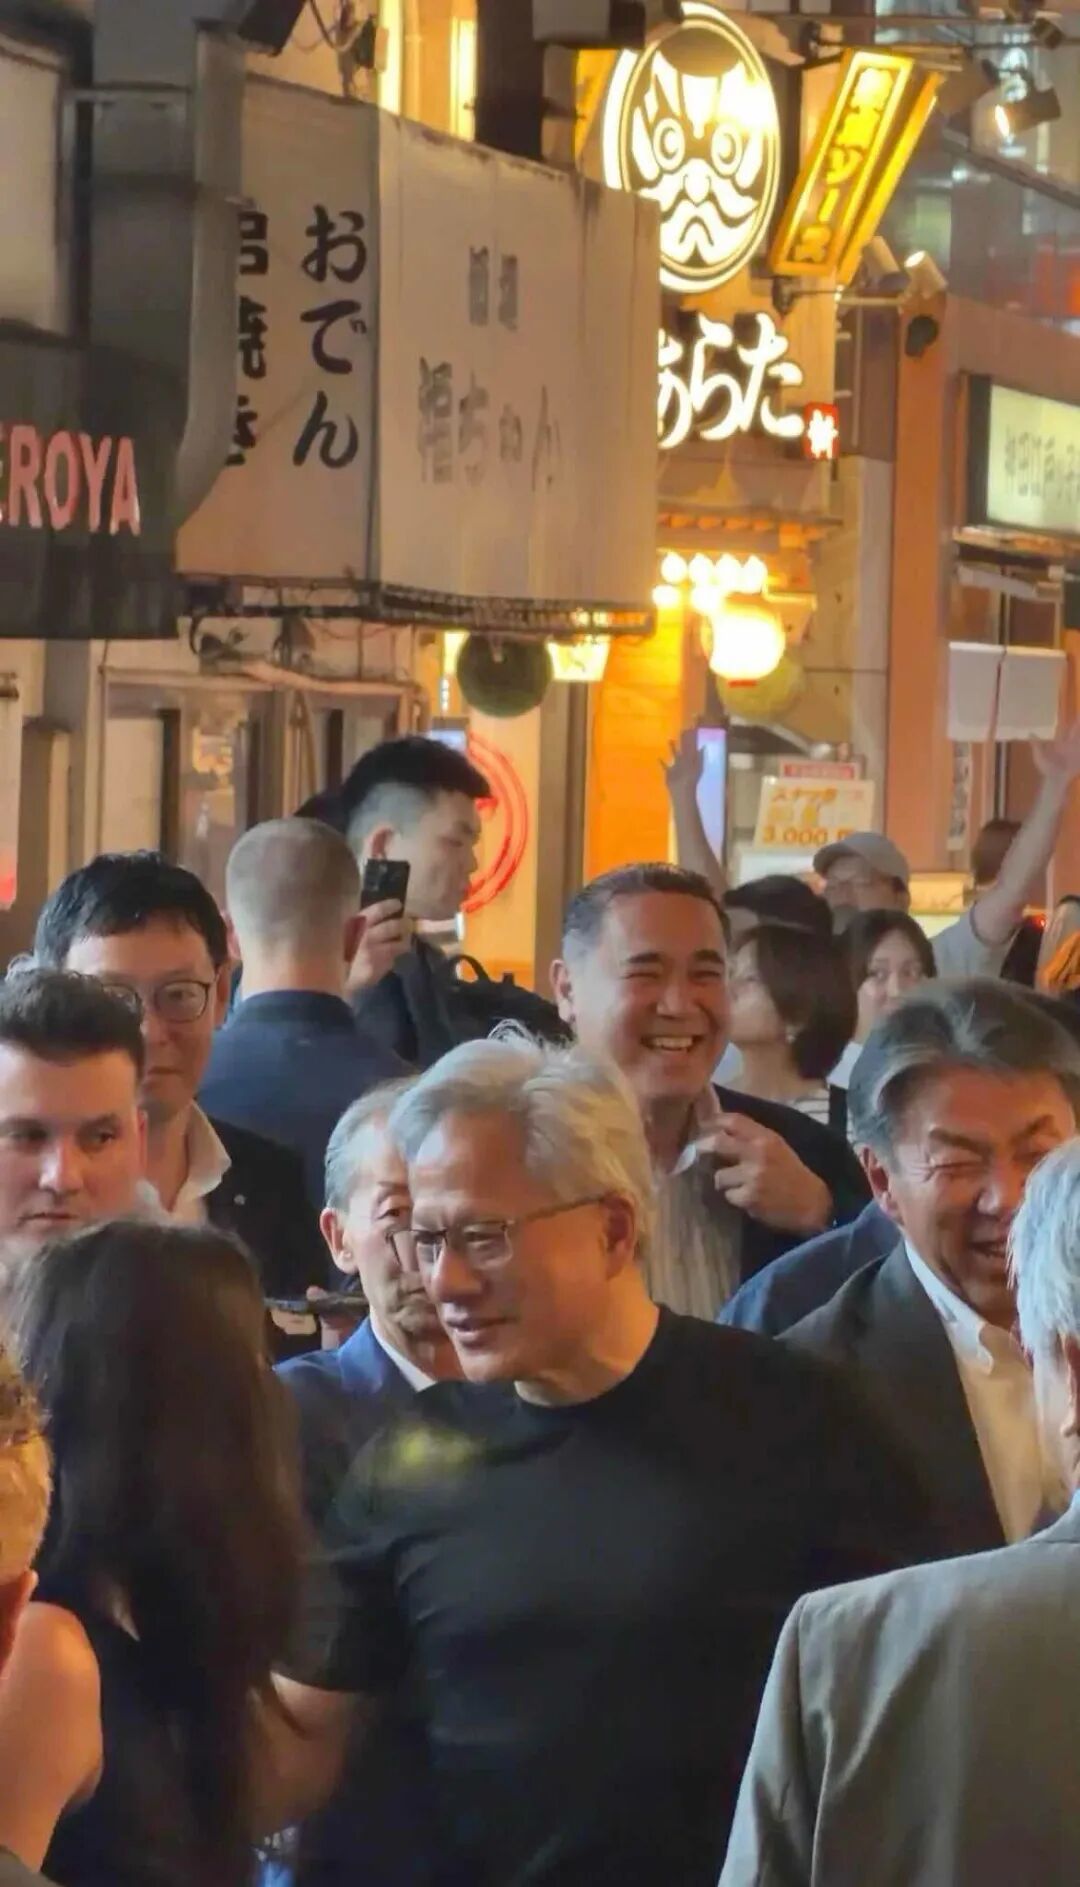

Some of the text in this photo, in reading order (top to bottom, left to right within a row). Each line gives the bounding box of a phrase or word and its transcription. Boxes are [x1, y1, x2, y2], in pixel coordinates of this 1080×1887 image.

[293, 204, 367, 470] おでん
[0, 421, 141, 536] ROYA
